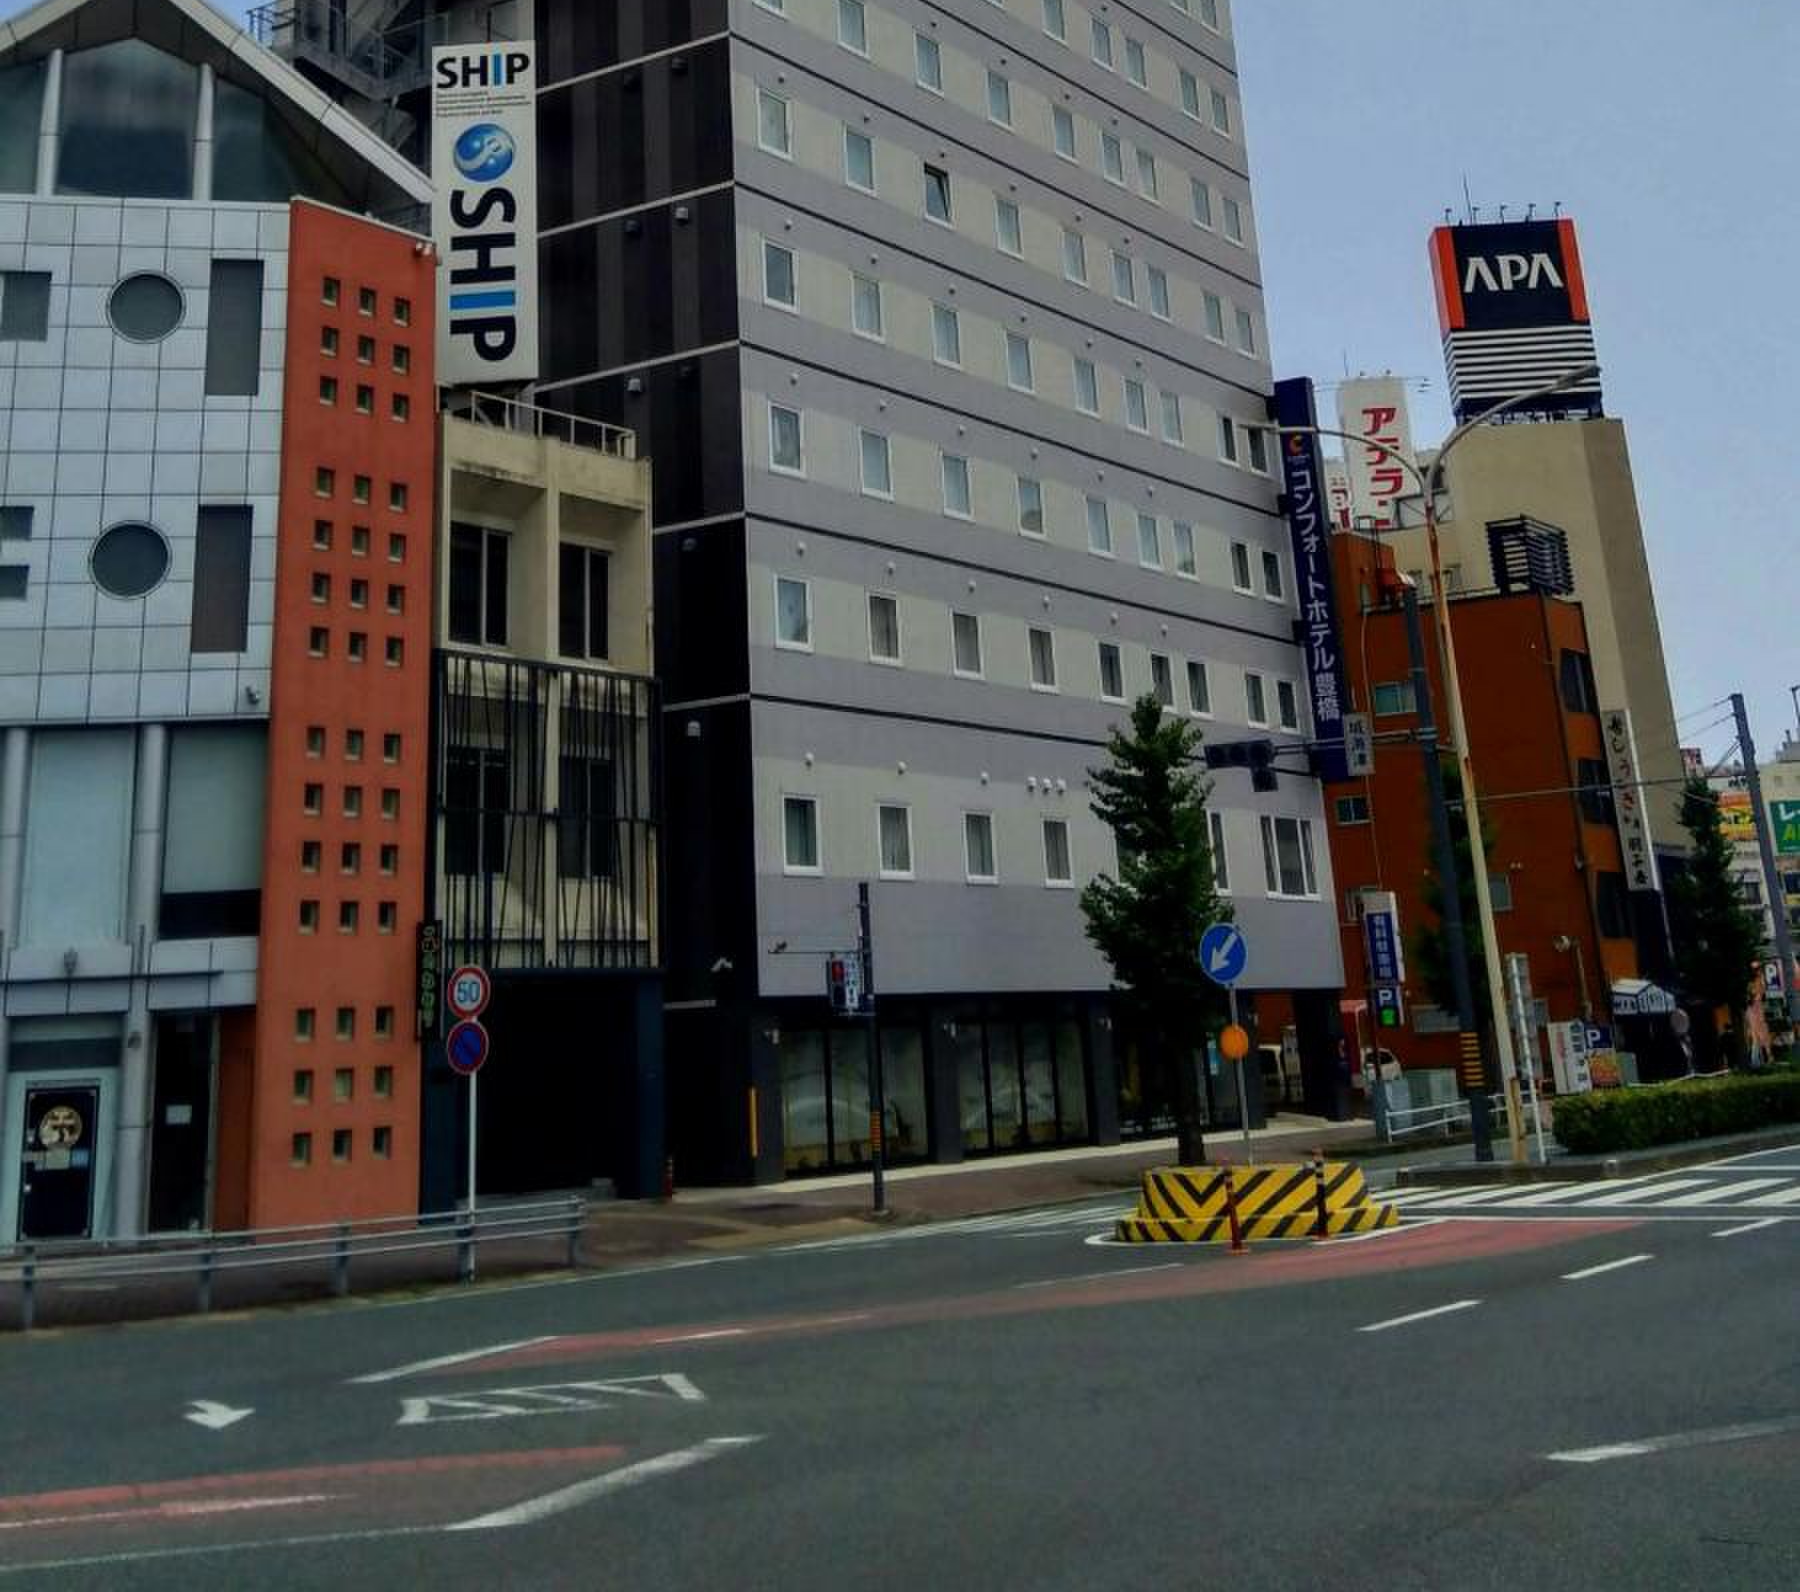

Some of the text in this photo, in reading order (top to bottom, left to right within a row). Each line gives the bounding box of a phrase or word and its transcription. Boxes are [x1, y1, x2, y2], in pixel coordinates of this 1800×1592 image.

[436, 53, 530, 89] SHIP
[450, 187, 517, 363] SHIP
[1463, 253, 1564, 293] APA
[457, 980, 481, 1002] 50
[1379, 990, 1392, 1006] P
[1586, 1029, 1601, 1048] P
